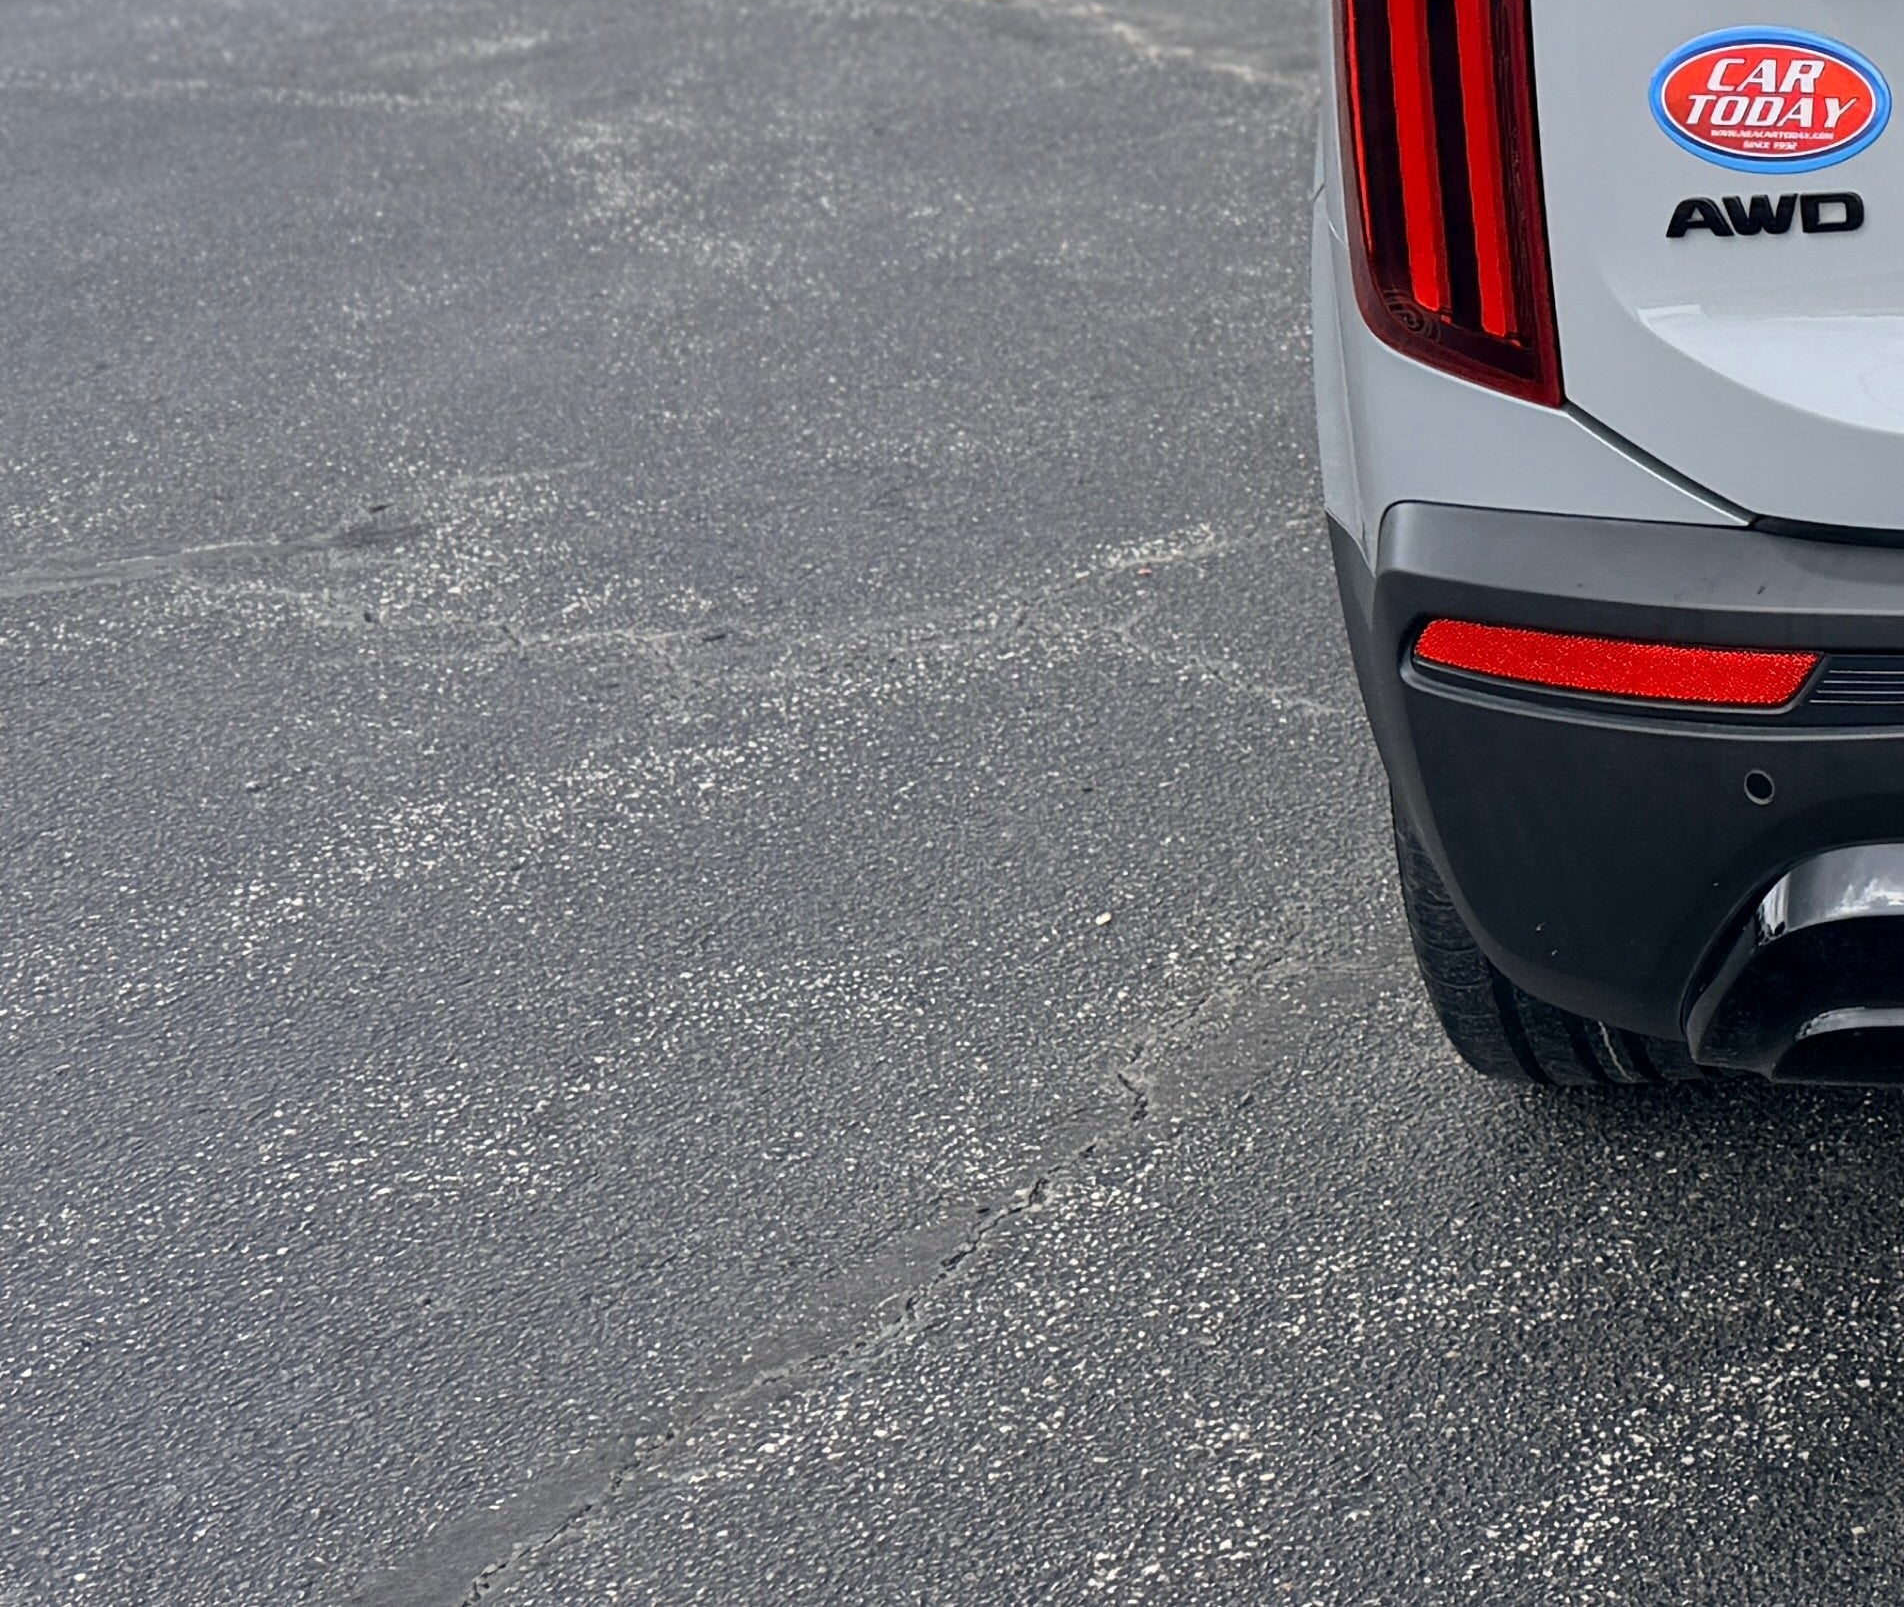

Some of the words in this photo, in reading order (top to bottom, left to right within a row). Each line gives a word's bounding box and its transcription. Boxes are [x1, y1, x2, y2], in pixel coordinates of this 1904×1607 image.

[1706, 58, 1825, 93] CAR
[1686, 94, 1858, 128] TODAY
[1666, 191, 1865, 238] AWD
